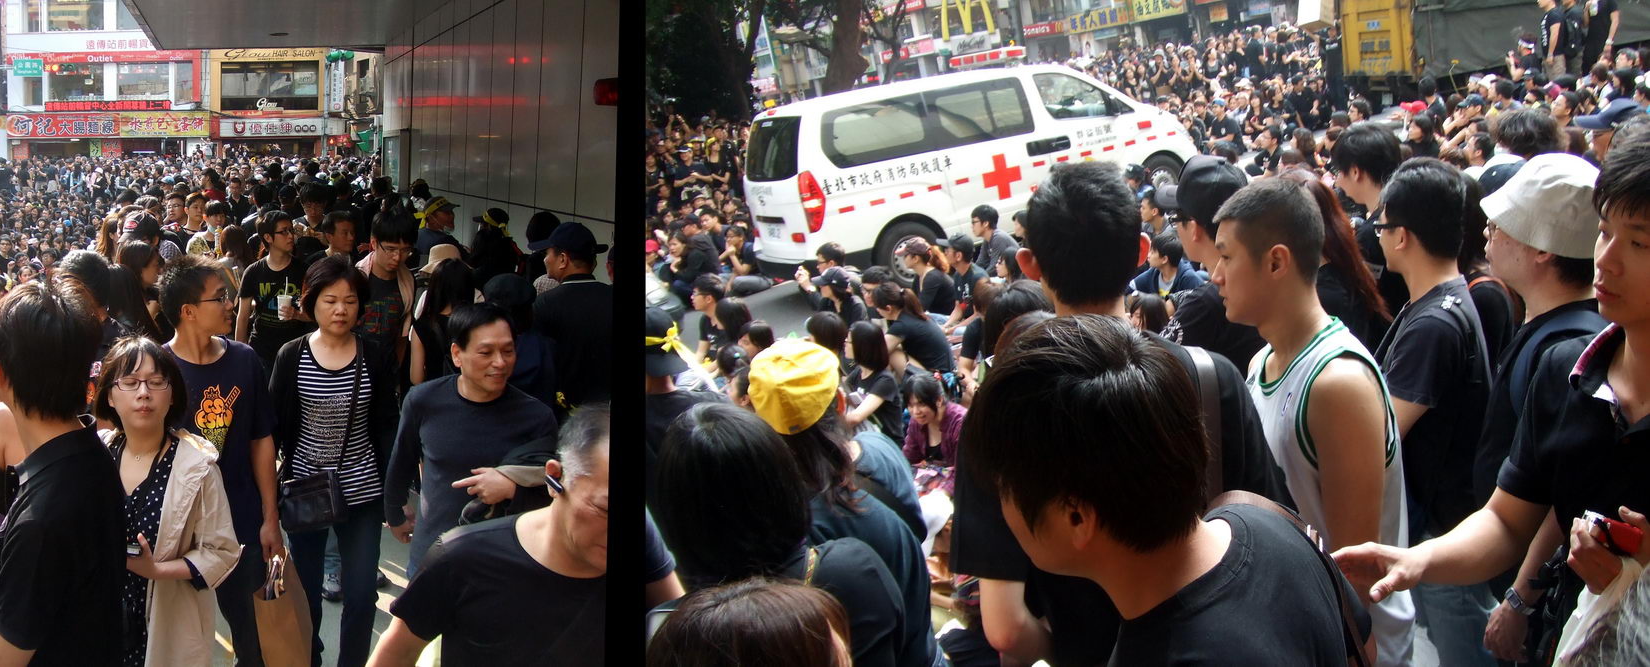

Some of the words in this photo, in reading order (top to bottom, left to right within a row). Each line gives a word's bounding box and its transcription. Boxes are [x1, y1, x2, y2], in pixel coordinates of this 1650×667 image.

[14, 118, 56, 136] 何記
[59, 121, 115, 135] 大腸麵線
[178, 116, 204, 132] 蛋餅
